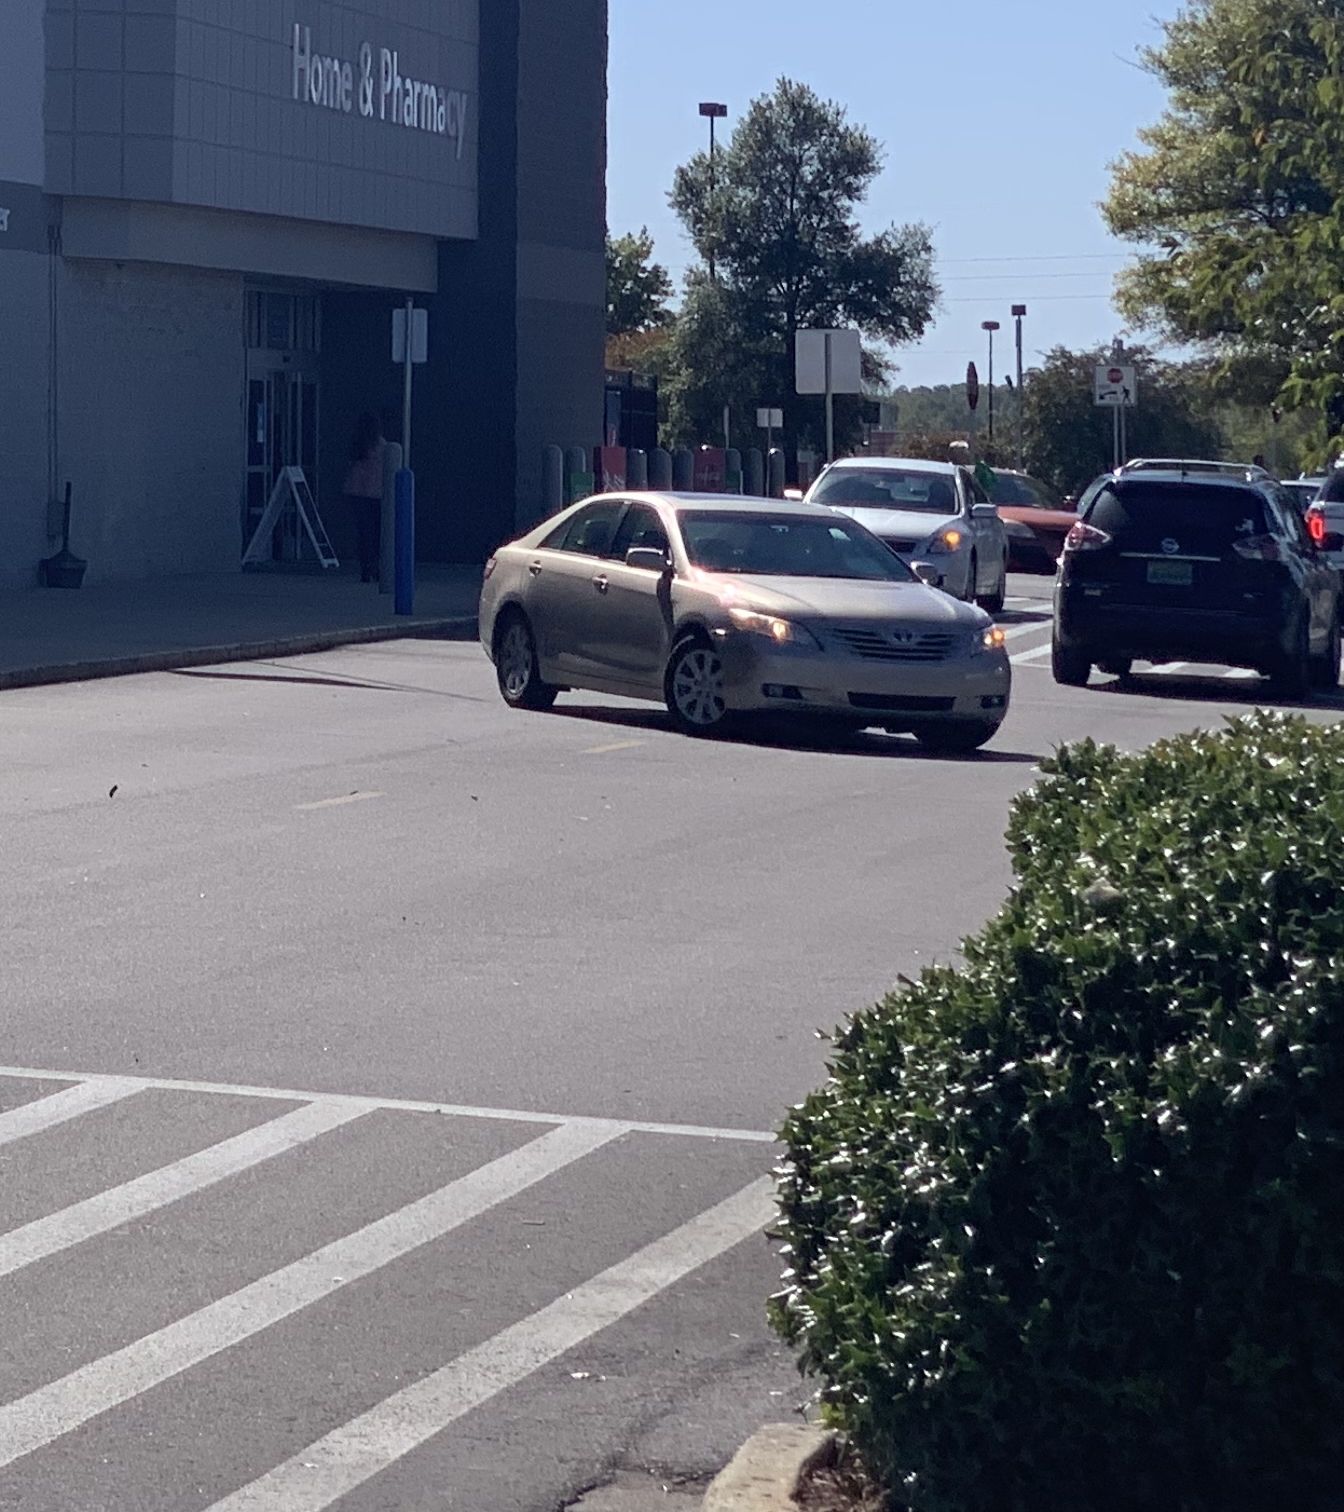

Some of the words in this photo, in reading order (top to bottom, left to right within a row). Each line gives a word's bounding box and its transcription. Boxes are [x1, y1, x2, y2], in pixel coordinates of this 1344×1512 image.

[293, 23, 354, 113] Home
[359, 42, 374, 117] &
[380, 48, 468, 160] Pharmacy
